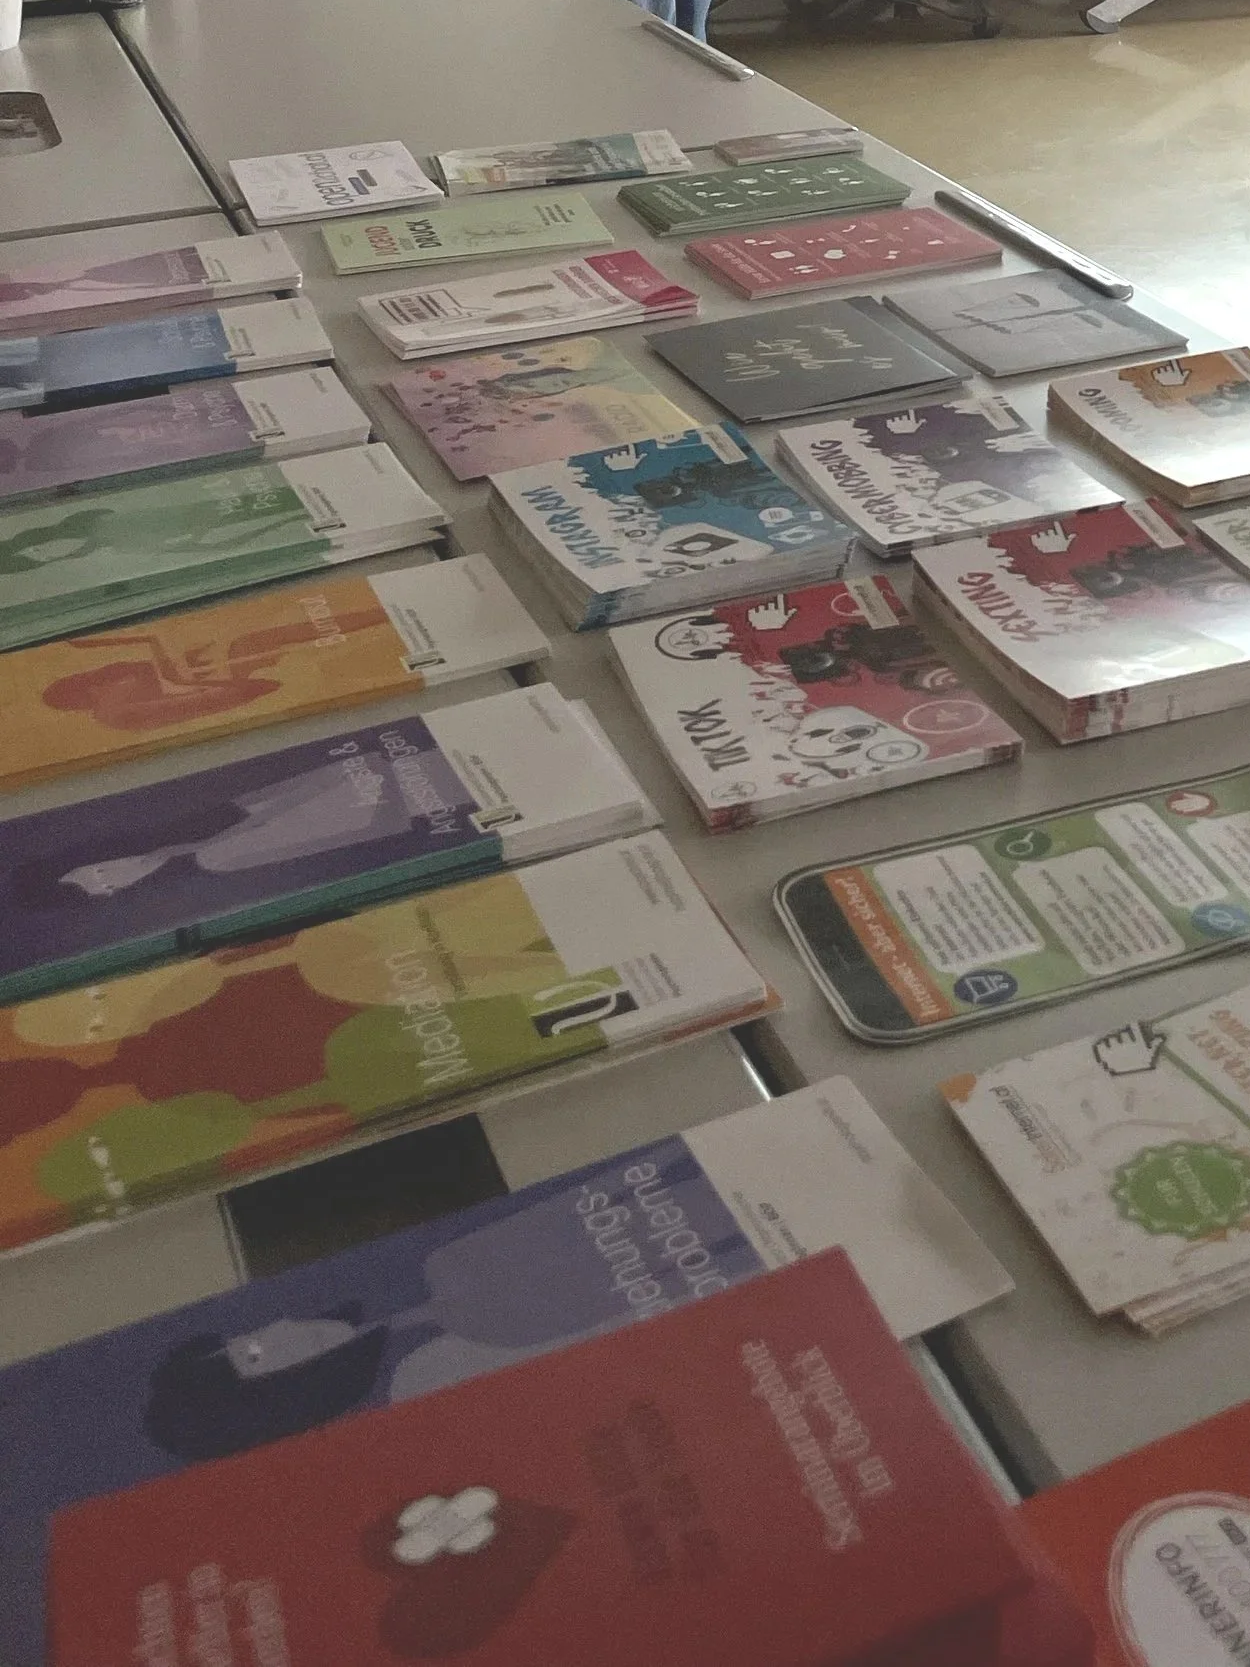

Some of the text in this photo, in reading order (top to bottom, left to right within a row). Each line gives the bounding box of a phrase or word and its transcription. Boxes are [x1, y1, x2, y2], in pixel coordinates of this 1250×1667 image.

[364, 226, 402, 257] JUGEND
[405, 219, 443, 250] DRUCK
[810, 438, 908, 536] CYBERMOBBING
[520, 484, 626, 570] INSTAGRAM
[956, 570, 1057, 643] SEXTING
[834, 876, 876, 922] sicher!
[867, 923, 896, 953] aber
[385, 948, 474, 1087] Mediation
[892, 961, 941, 1018] Internet
[740, 1338, 864, 1552] Seminarangebote
[791, 1345, 894, 1499] im Überblick
